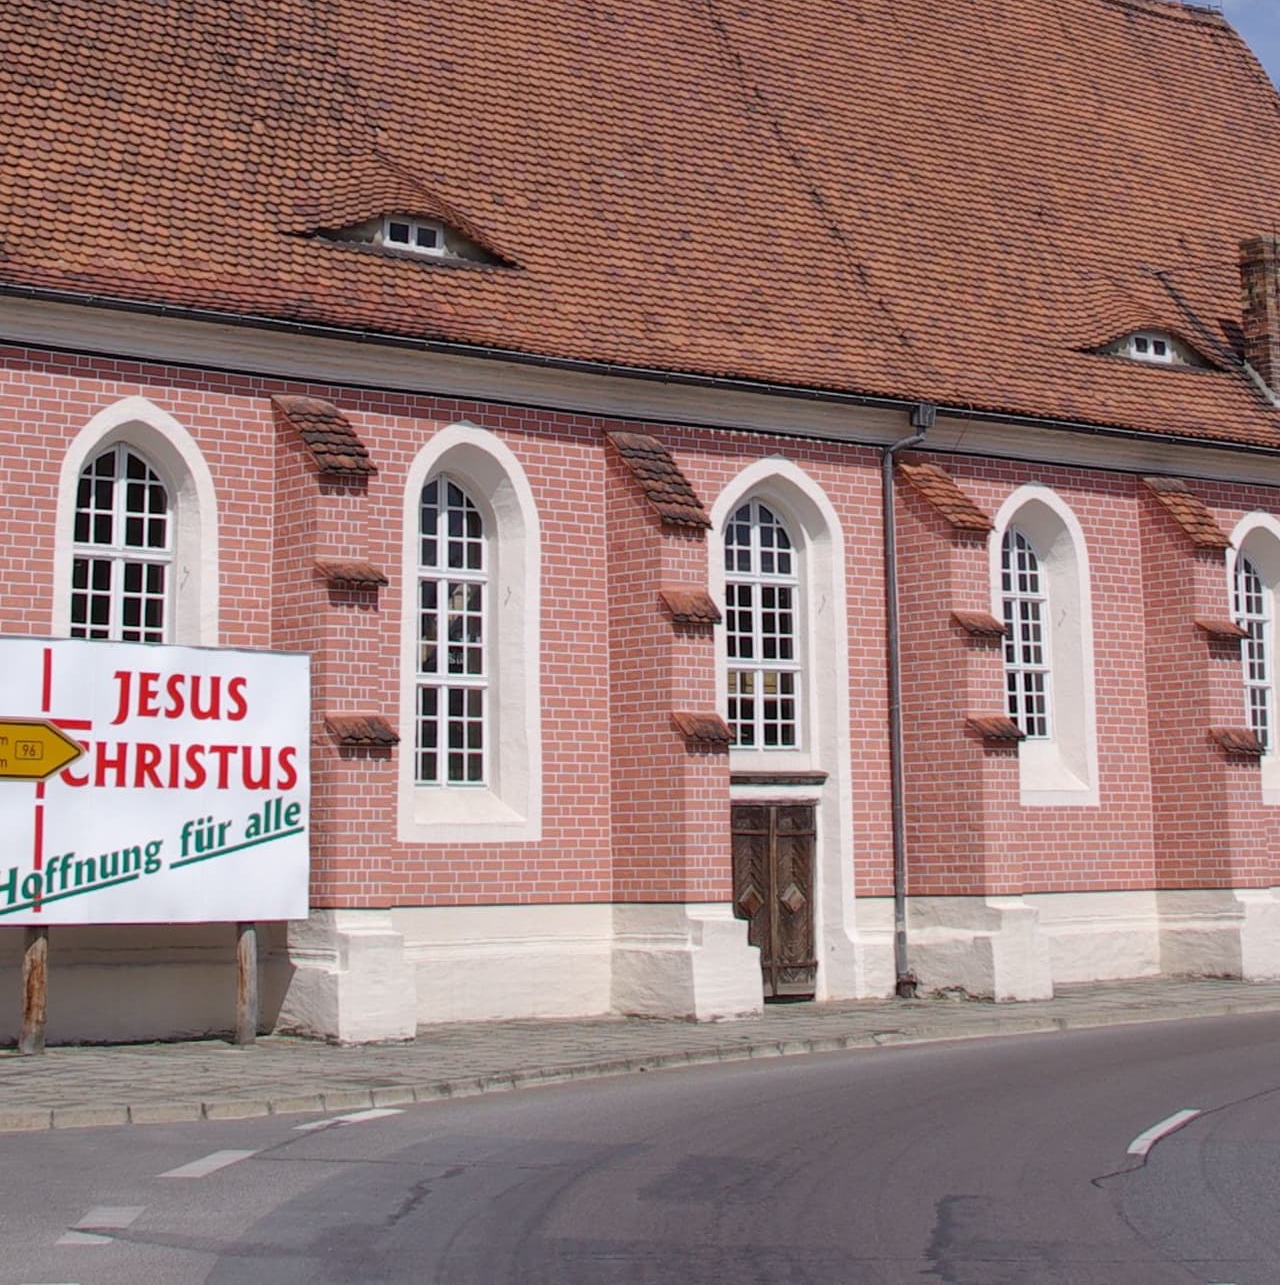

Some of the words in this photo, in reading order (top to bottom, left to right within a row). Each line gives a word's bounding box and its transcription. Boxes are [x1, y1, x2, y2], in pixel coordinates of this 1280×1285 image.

[109, 670, 248, 725] JESUS
[22, 743, 36, 757] 96
[179, 814, 232, 858] für
[244, 796, 302, 839] alle
